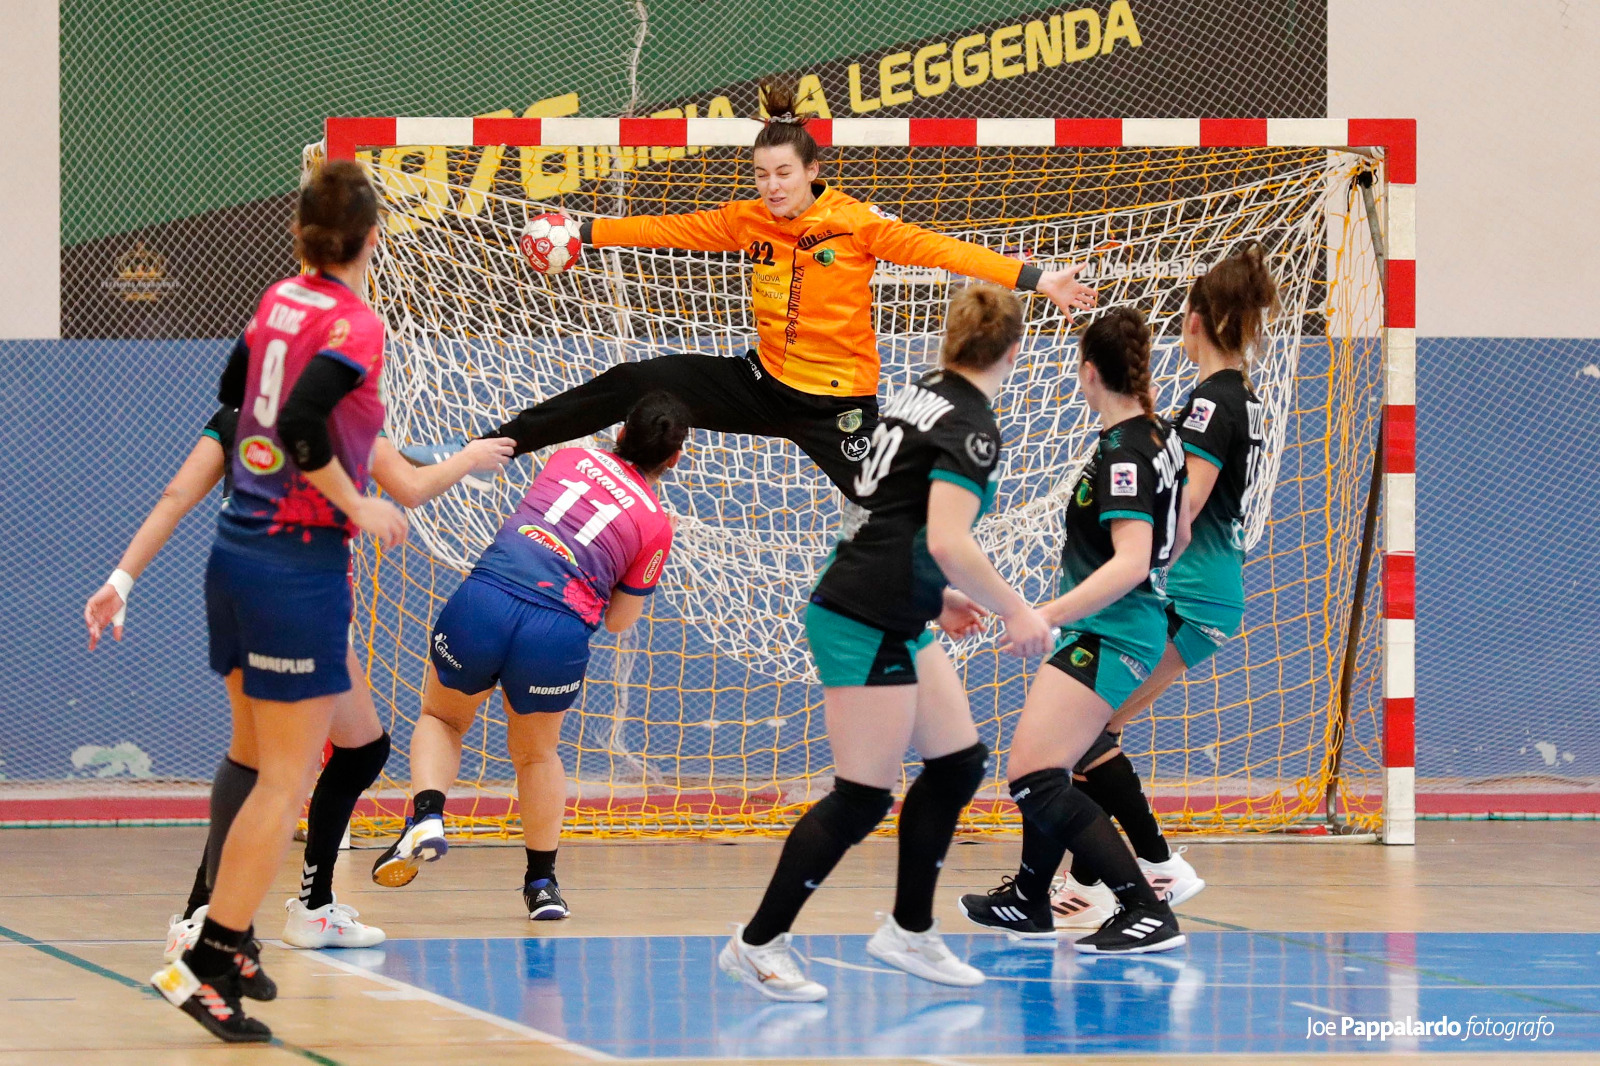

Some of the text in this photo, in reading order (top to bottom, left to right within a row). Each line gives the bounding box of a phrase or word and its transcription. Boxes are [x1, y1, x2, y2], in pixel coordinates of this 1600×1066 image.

[848, 1, 1142, 113] LEGGENDA
[749, 240, 776, 266] 22
[253, 338, 288, 428] 9
[543, 478, 622, 547] 11
[248, 652, 316, 674] MOREPLUS
[528, 680, 581, 696] MOREPLUS
